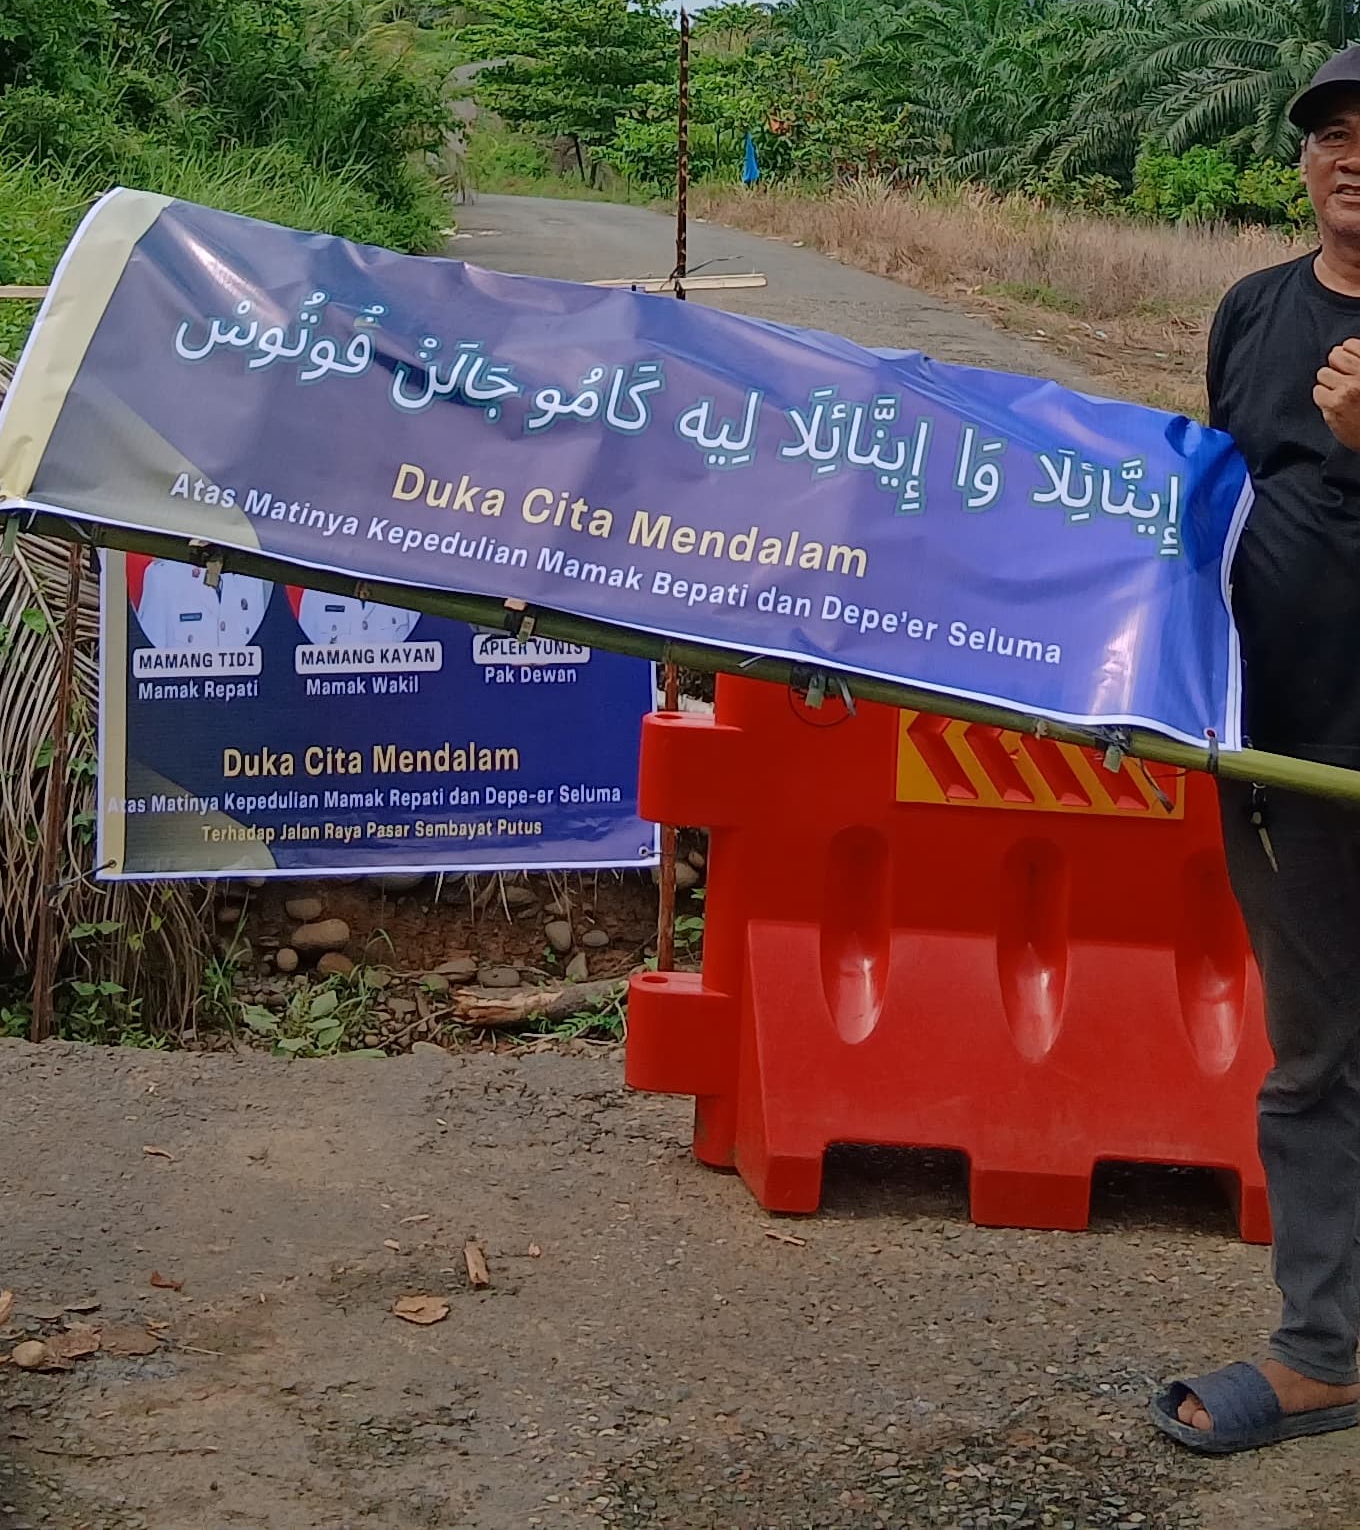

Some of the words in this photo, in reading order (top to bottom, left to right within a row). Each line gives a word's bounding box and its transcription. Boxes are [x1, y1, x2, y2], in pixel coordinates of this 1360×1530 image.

[391, 463, 506, 519] Duka
[521, 487, 614, 539] Cita
[628, 510, 869, 579] Mendalam
[169, 472, 236, 510] Atas
[243, 488, 360, 536] Matinya
[367, 517, 529, 569] Kepedulian
[536, 547, 643, 591] Mamak
[651, 571, 749, 608] Bepati
[757, 586, 812, 619] dan
[948, 621, 1063, 665] Seluma
[139, 652, 213, 669] MAMANG
[218, 651, 255, 668] TIDI
[300, 648, 375, 665] MAMANG
[380, 647, 436, 664] KAYAN
[306, 676, 367, 696] Mamak
[372, 675, 419, 694] Wakil
[484, 665, 515, 684] Pak
[520, 666, 577, 683] Dewan
[138, 680, 199, 700] Mamak
[204, 679, 259, 702] Repati
[222, 746, 294, 778] Duka
[304, 745, 362, 776] Cita
[372, 742, 520, 774] Mendalam
[151, 793, 219, 815] Matinya
[224, 790, 319, 814] Kepedulian
[323, 789, 383, 808] Mamak
[389, 787, 444, 810] Repati
[449, 786, 480, 805] dan
[485, 786, 554, 808] Depe-er
[558, 783, 622, 804] Seluma
[201, 824, 276, 845] Terhadap
[279, 823, 320, 841] Jalan
[323, 822, 362, 843] Raya
[366, 821, 410, 839] Pasar
[414, 819, 493, 840] Sembayat
[497, 818, 543, 836] Putus
